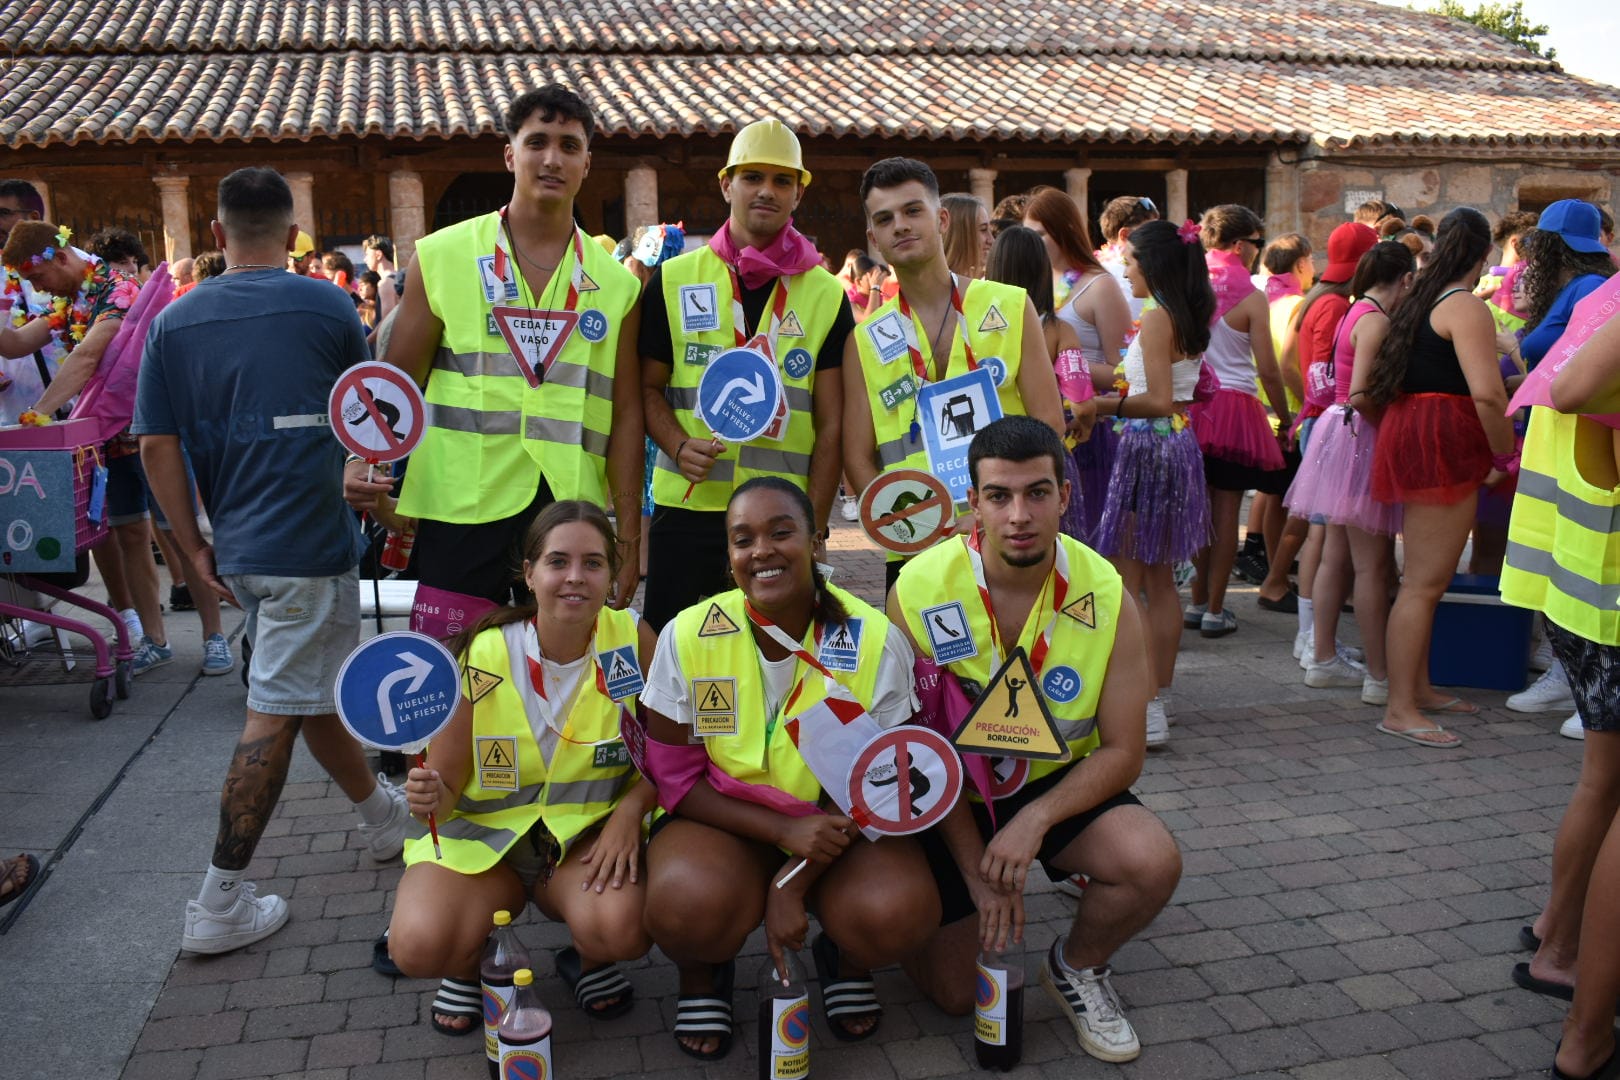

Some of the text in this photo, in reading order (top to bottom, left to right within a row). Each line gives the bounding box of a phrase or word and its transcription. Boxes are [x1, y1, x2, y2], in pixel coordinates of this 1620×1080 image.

[513, 319, 558, 331] CEDA EL
[584, 315, 603, 330] 30
[520, 335, 549, 345] VASO
[788, 353, 806, 370] 30
[728, 399, 751, 421] VUELVE
[721, 408, 729, 417] LA
[730, 416, 752, 434] FIESTA
[1051, 671, 1075, 692] 30
[1047, 684, 1067, 700] CAÑAS
[397, 691, 446, 710] VUELVE A
[399, 703, 449, 723] LA FIESTA
[975, 721, 1041, 737] PRECAUCIÓN:
[987, 733, 1030, 745] BORRACHO
